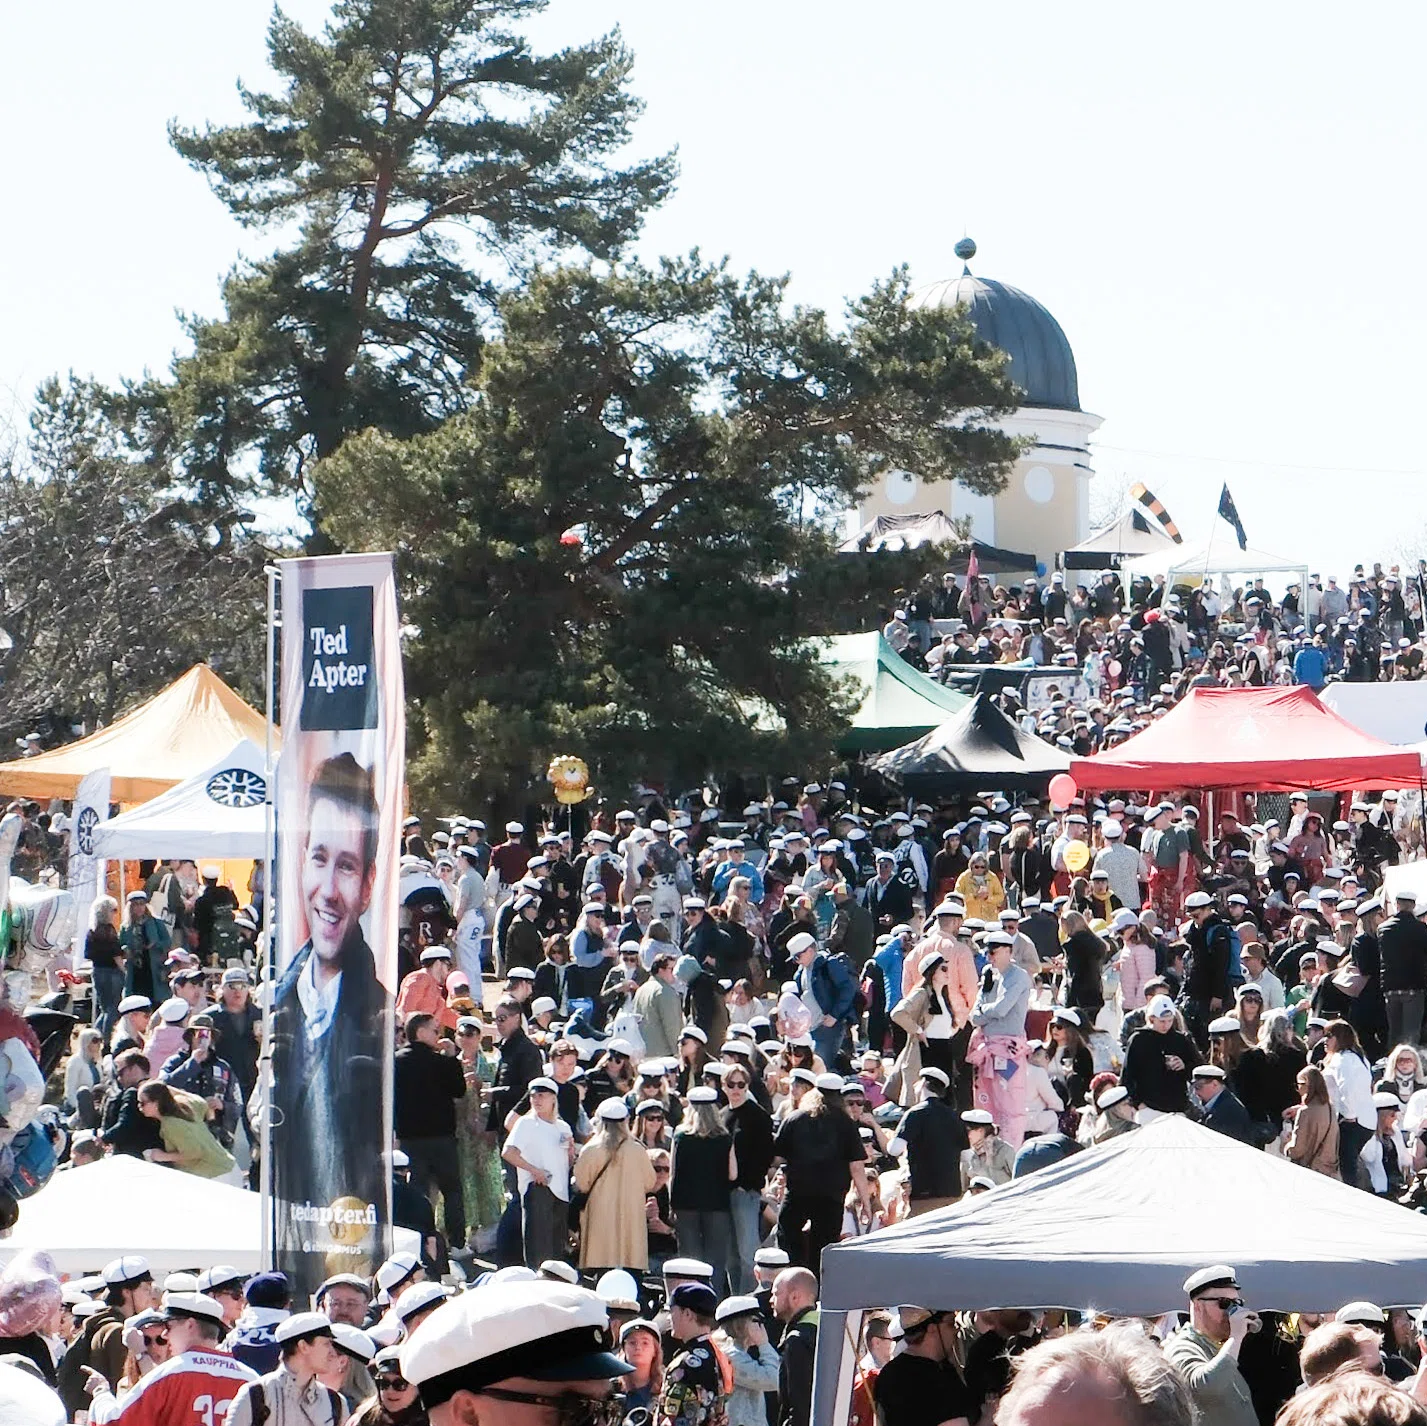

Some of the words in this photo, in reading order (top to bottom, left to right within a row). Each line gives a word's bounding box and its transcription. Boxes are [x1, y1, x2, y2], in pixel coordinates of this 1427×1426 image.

[310, 624, 348, 655] Ted
[308, 659, 367, 694] Apter
[291, 1200, 378, 1228] tedapter.fi
